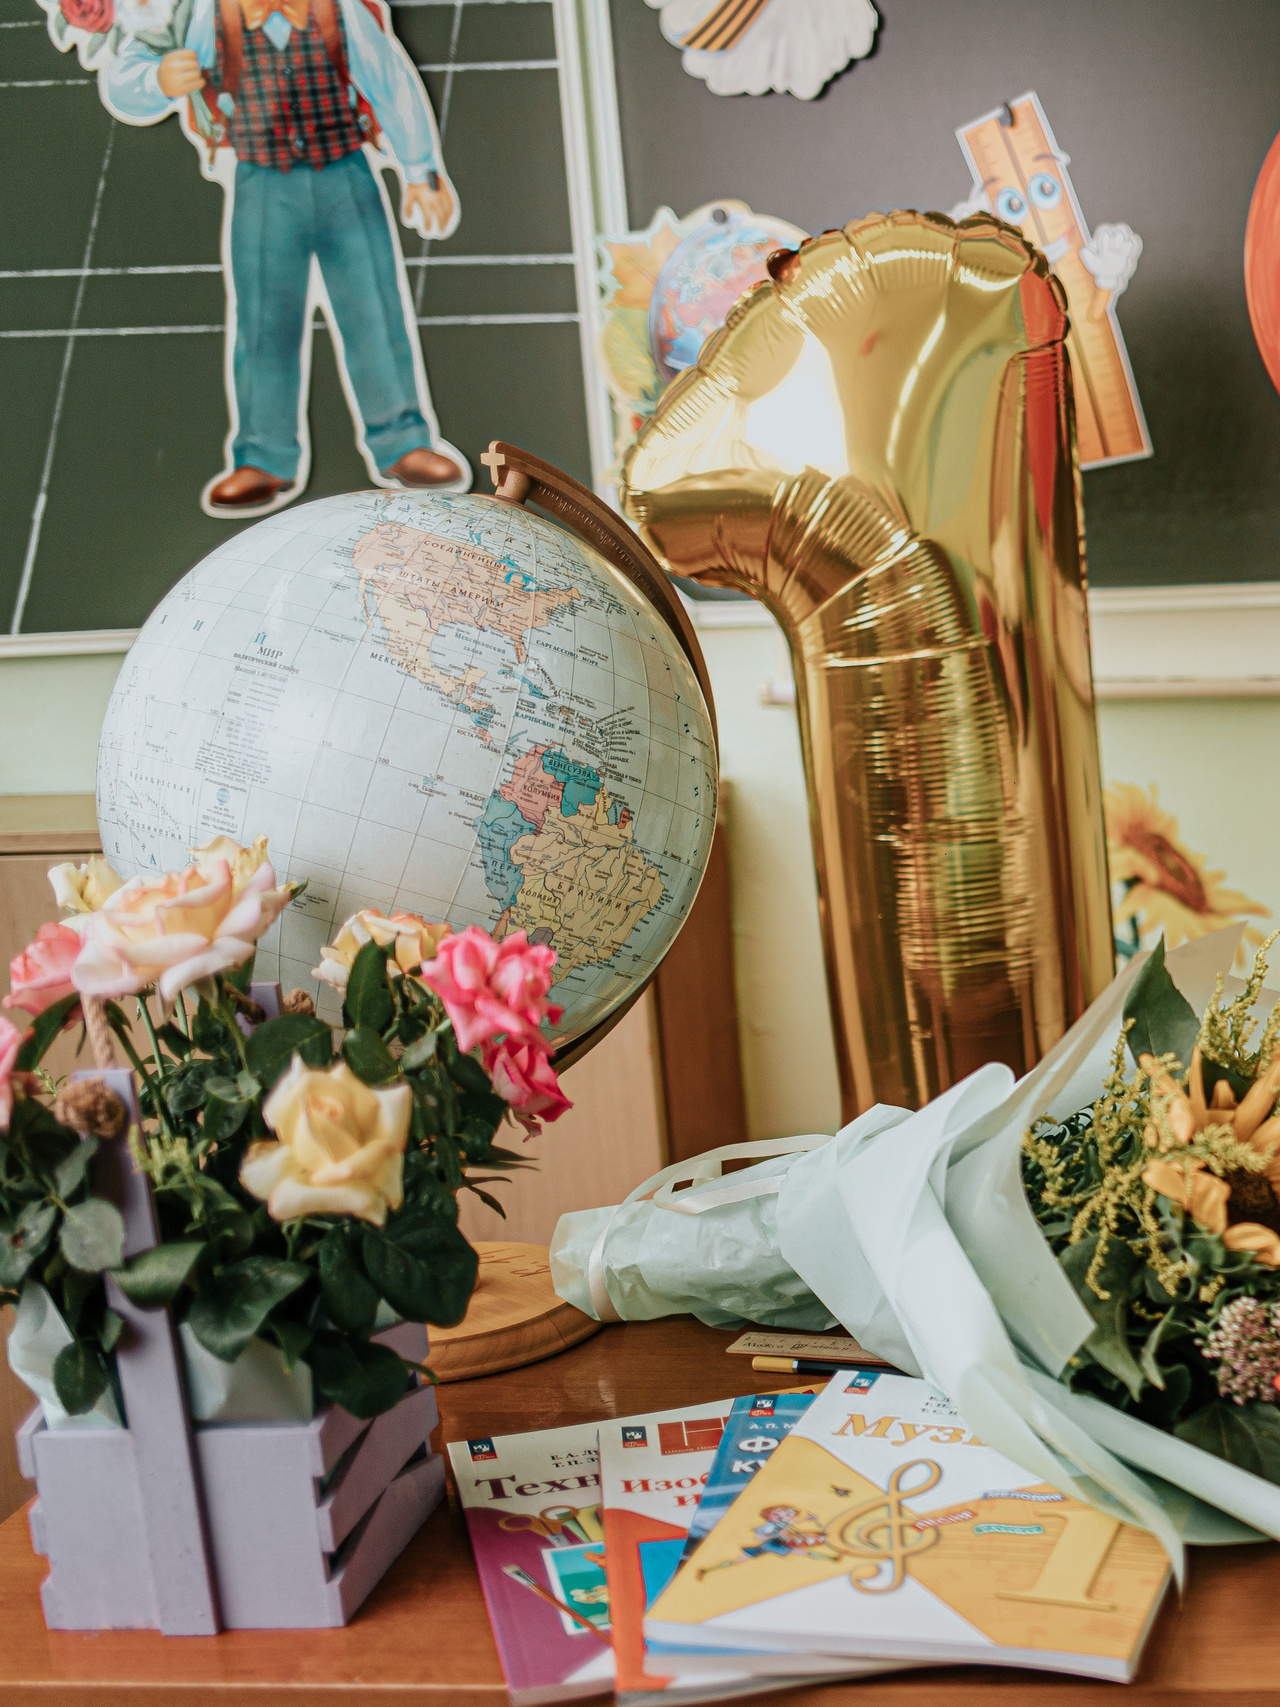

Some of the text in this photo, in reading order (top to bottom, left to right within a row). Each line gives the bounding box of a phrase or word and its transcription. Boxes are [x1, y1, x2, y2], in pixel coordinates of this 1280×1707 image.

[400, 571, 504, 608] ШТАТЫ АМЕРИКИ
[256, 647, 283, 659] МИР
[536, 640, 578, 659] САРГАССОВО
[582, 656, 598, 666] МОРЕ
[370, 652, 417, 672] МЕКСИКА
[558, 725, 576, 736] МОРЕ
[378, 757, 390, 765] 100
[548, 760, 591, 778] ВЕНЕСУЭЛА
[458, 790, 486, 801] ЭКВАДОР
[523, 785, 560, 801] КОЛУМБИЯ
[491, 860, 519, 874] ПЕРУ
[521, 888, 557, 903] БОЛИВИЯ
[557, 881, 630, 912] БРАЗИЛИЯ
[738, 1435, 779, 1453] Ф
